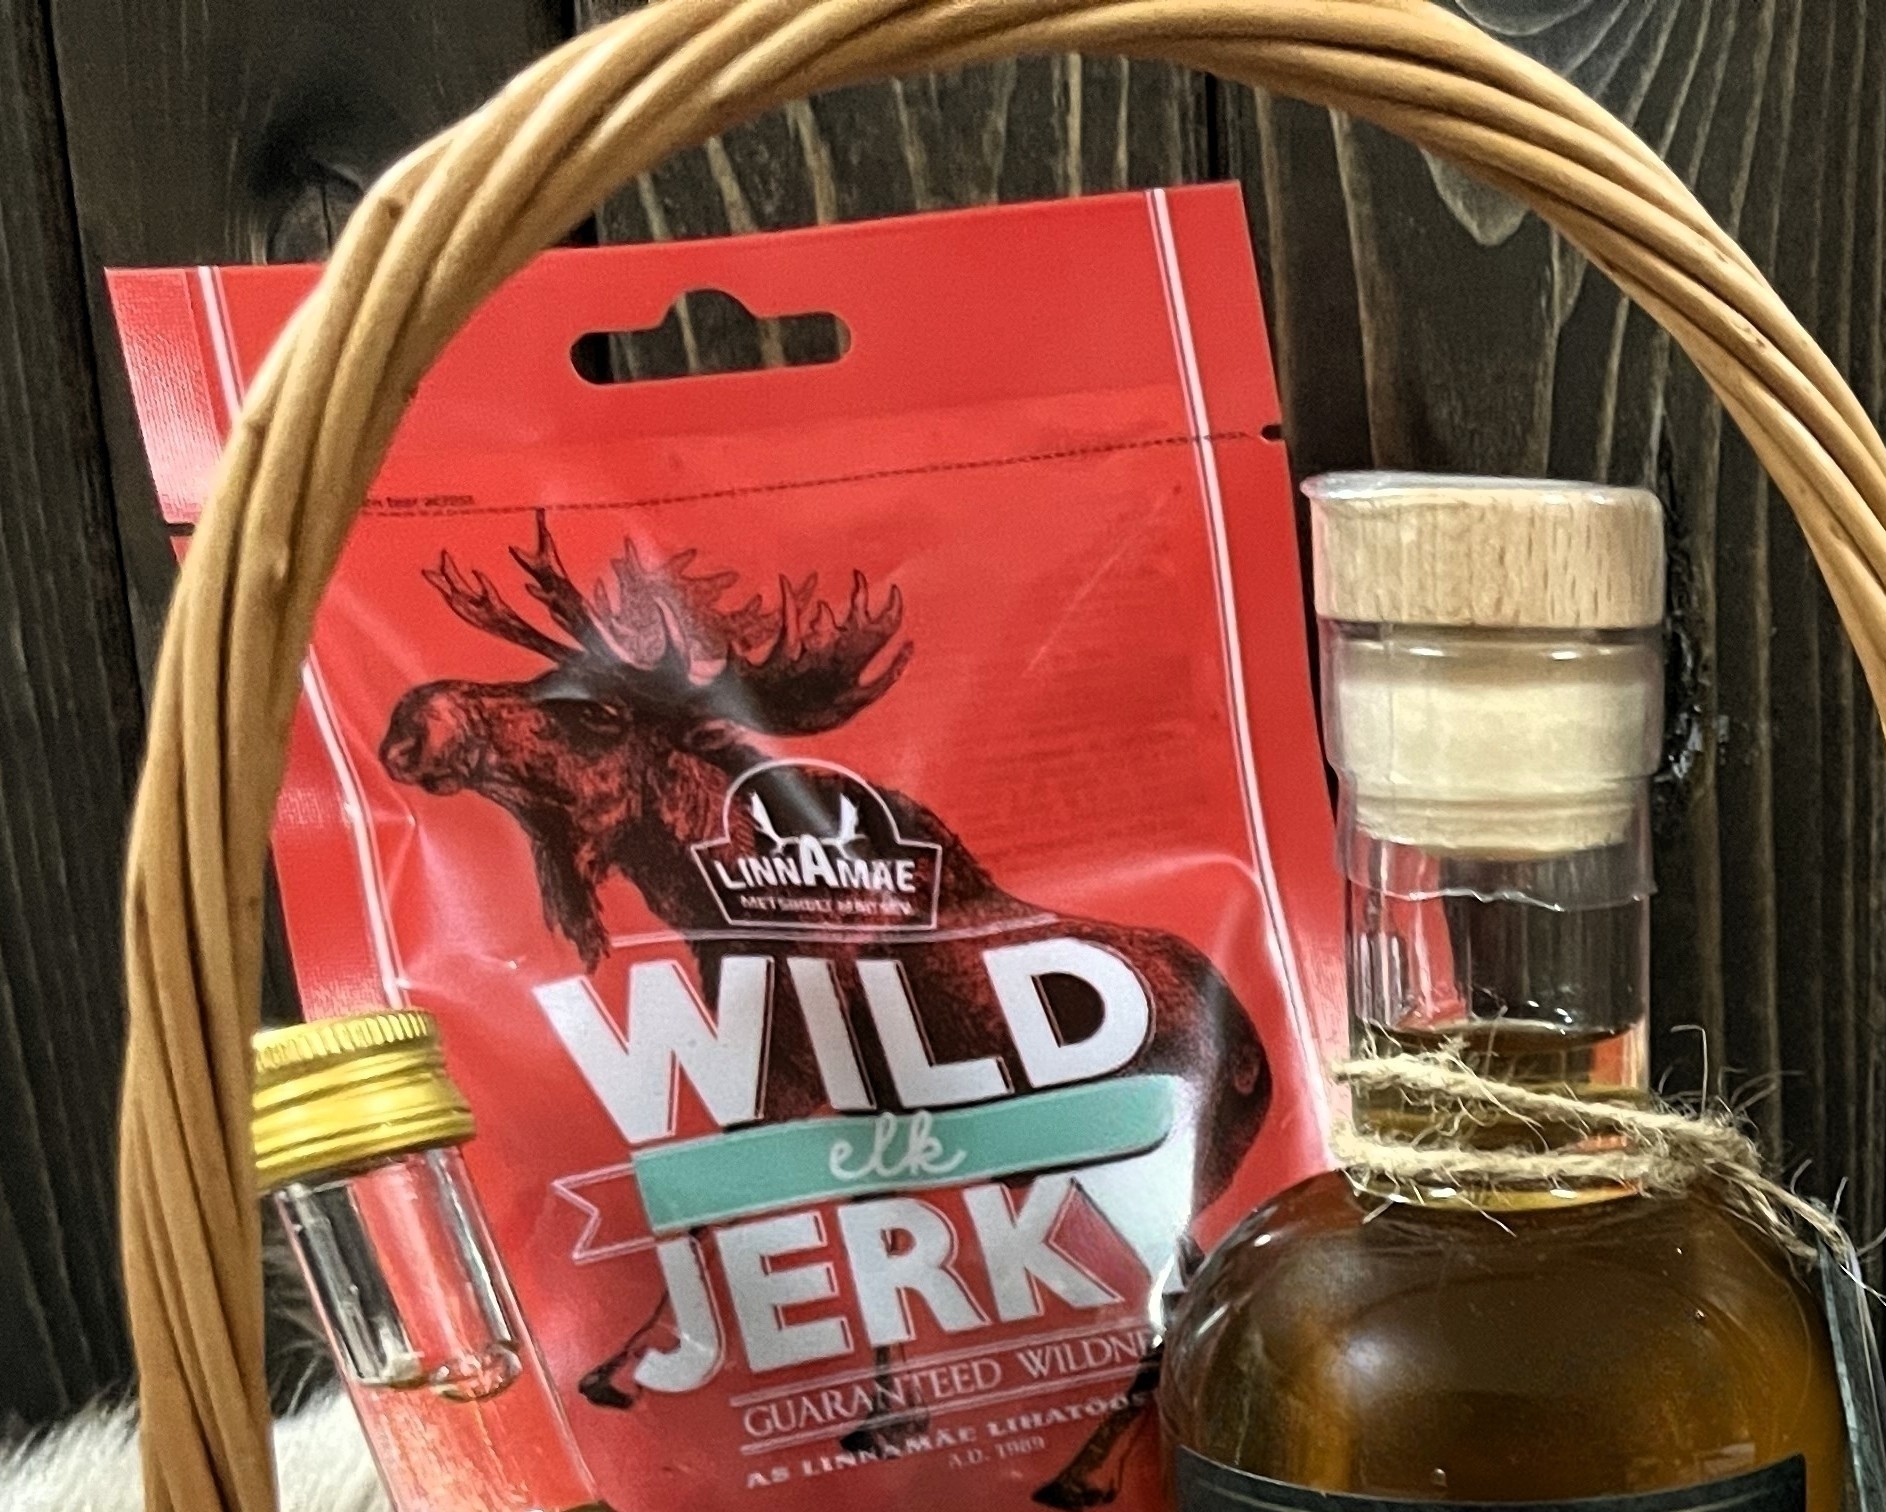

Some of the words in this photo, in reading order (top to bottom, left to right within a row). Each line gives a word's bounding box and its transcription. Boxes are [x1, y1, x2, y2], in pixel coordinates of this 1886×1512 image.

[532, 936, 1156, 1145] WILD
[828, 1111, 967, 1179] elk
[633, 1125, 1194, 1394] JERKY
[743, 1357, 1001, 1437] GUARANTEED
[747, 1467, 790, 1490] AS
